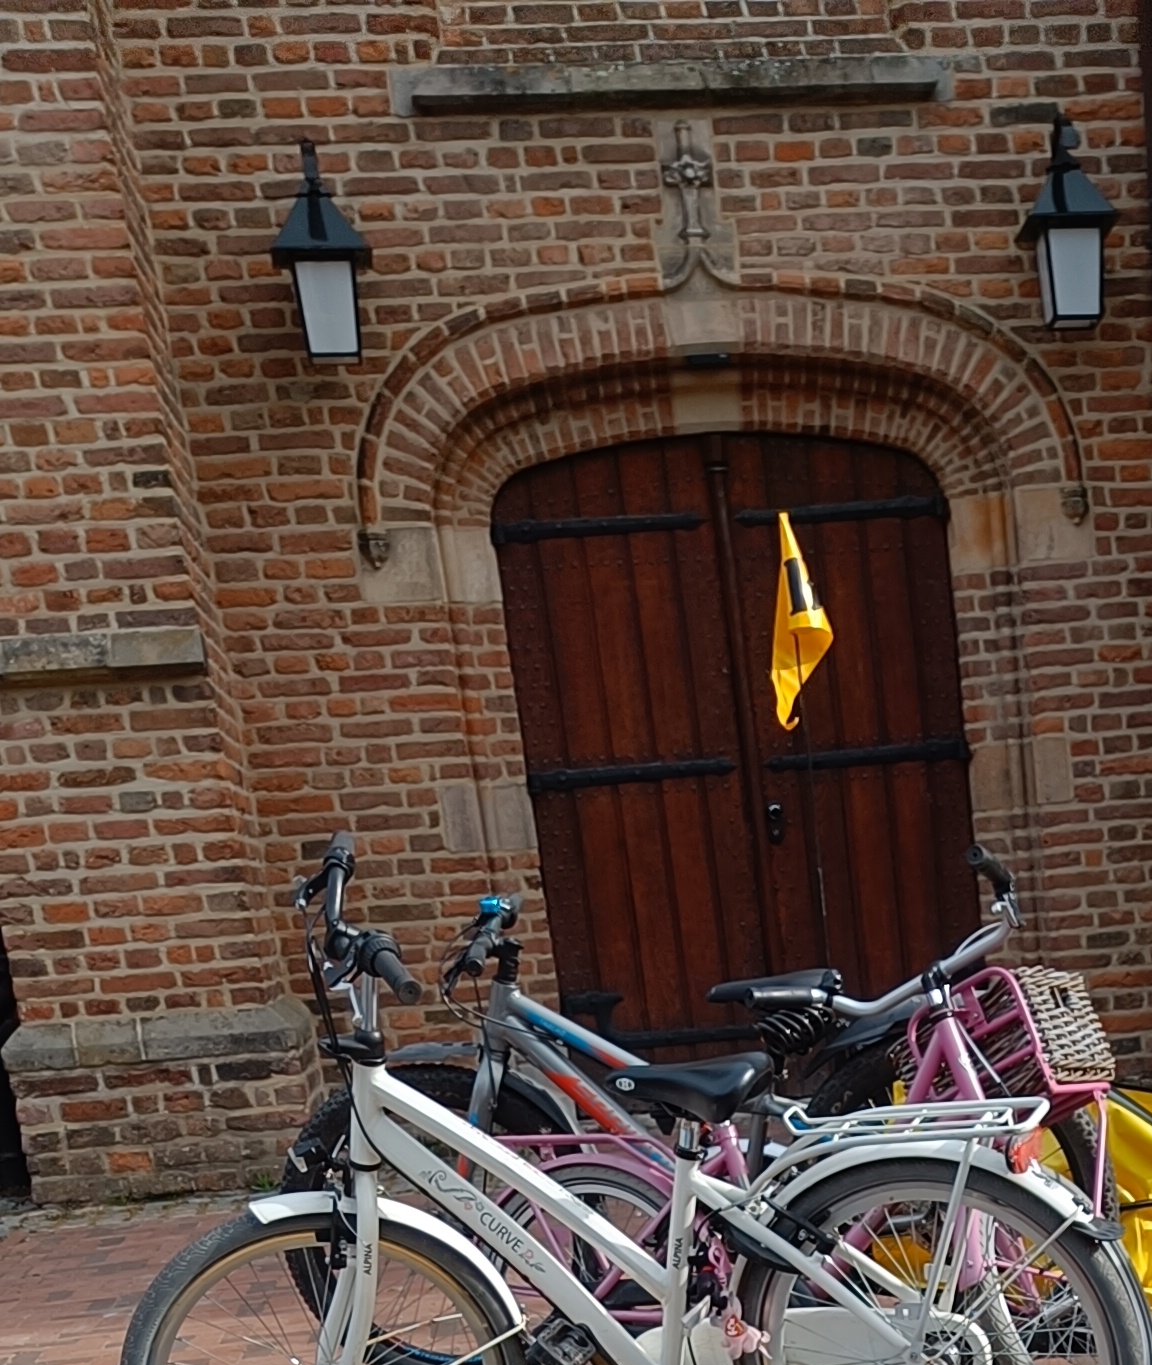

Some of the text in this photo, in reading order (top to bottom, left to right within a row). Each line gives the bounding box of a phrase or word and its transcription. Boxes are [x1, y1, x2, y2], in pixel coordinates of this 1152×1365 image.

[480, 1212, 524, 1255] CURVE
[362, 1240, 375, 1276] ALPINA
[672, 1237, 684, 1270] ALPINA
